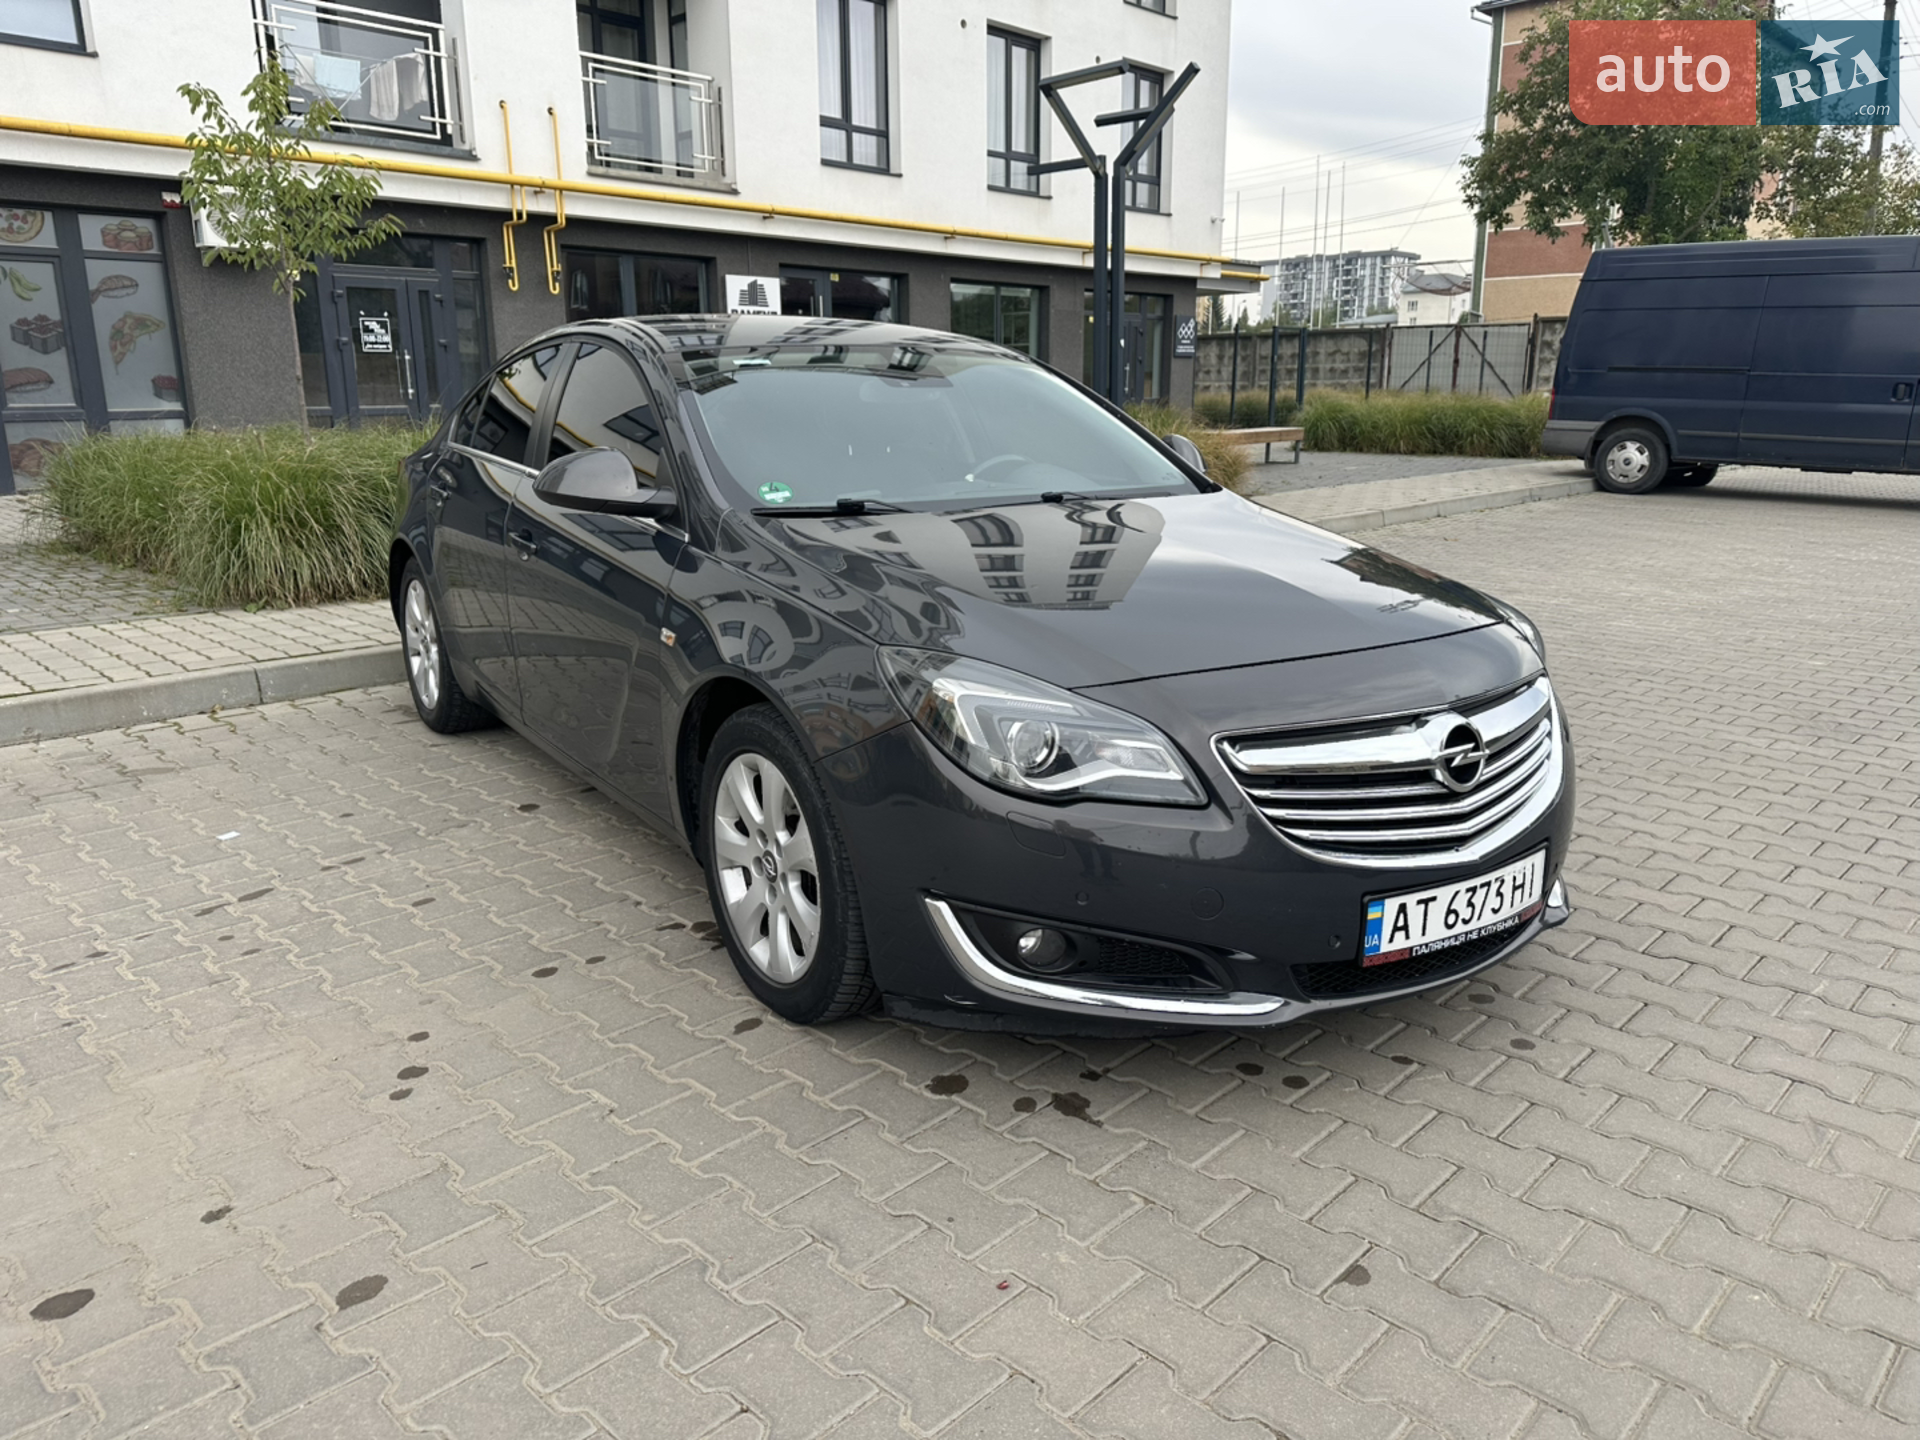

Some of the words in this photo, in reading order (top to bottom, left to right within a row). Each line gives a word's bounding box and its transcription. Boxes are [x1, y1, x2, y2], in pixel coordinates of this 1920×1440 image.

[1388, 895, 1437, 944] AT
[1444, 875, 1505, 930] 6373
[1365, 934, 1379, 948] UA
[1412, 933, 1465, 956] ПАЛЯНИЦЯ
[1466, 930, 1479, 941] НЕ
